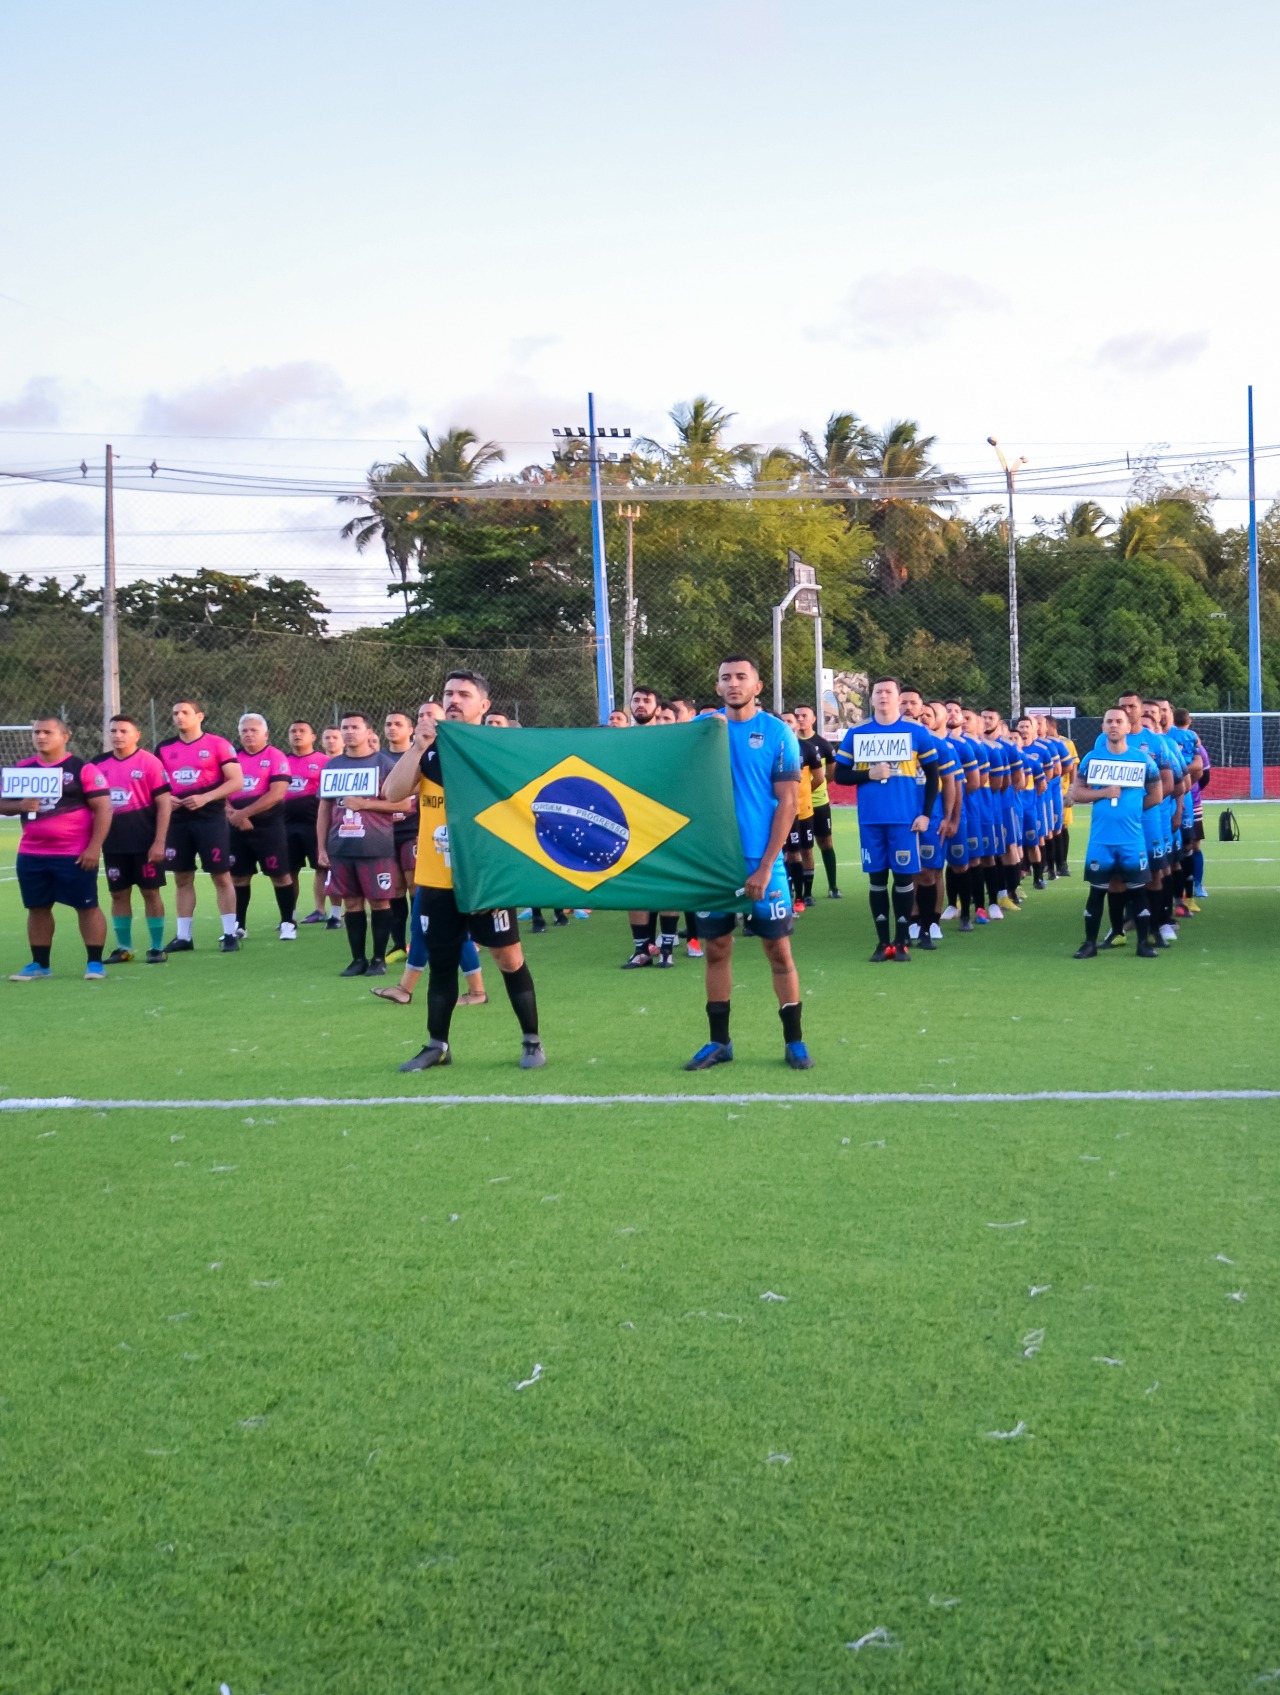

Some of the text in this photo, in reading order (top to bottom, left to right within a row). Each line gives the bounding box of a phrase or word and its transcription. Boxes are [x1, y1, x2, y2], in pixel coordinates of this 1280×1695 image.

[858, 735, 908, 757] MÁXIMA
[323, 772, 369, 792] CAUCAIA
[109, 791, 133, 801] RV
[533, 803, 562, 812] ORDEM
[576, 810, 627, 836] PROGRESSO
[211, 848, 221, 862] 2
[142, 864, 156, 878] 15
[769, 900, 787, 920] 16
[491, 910, 510, 932] 10
